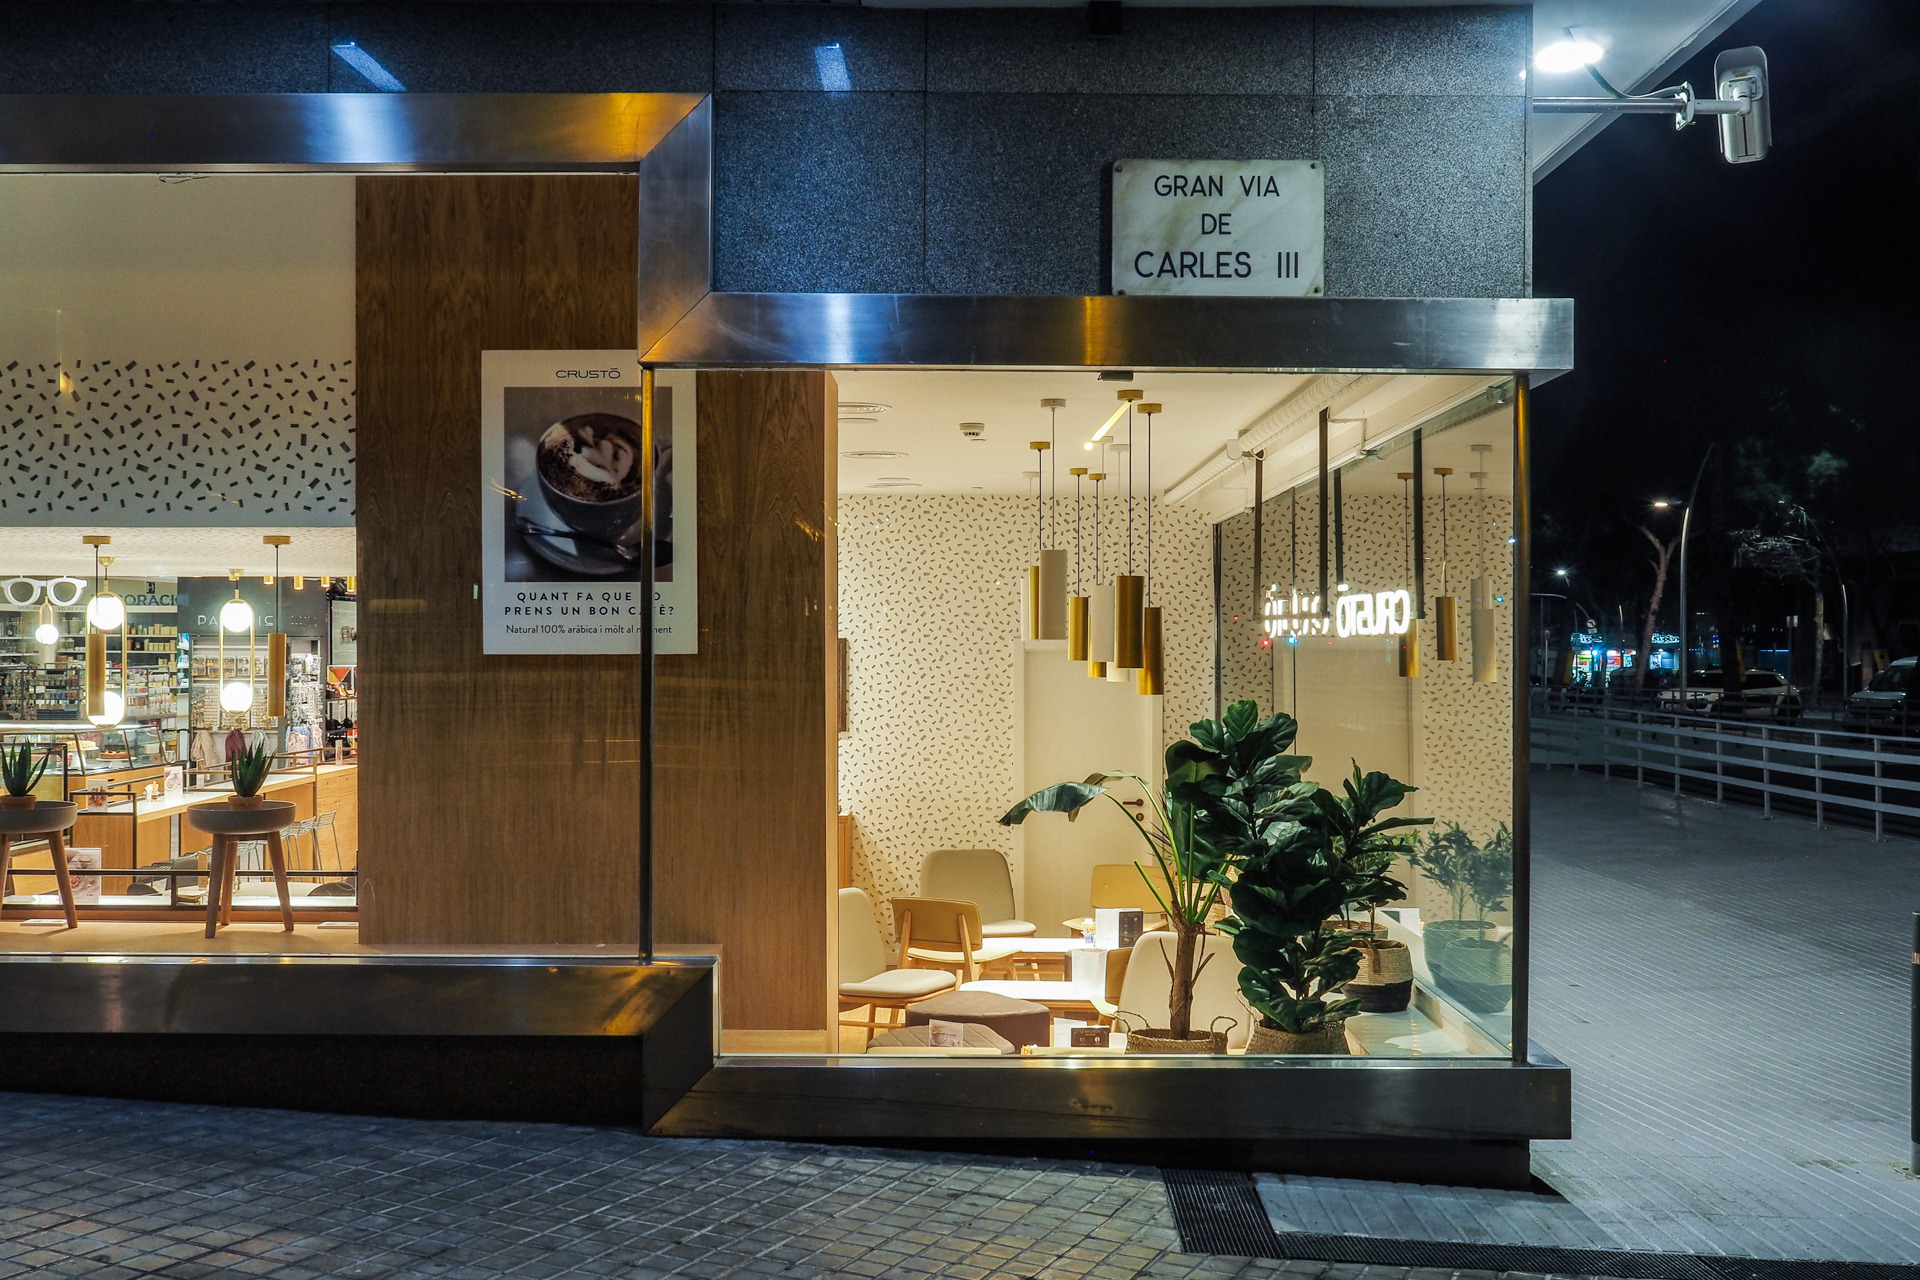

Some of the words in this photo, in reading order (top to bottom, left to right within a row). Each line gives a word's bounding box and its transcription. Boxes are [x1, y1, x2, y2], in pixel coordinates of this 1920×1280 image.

[1154, 174, 1224, 197] GRAN
[1239, 175, 1280, 197] VIA
[1201, 213, 1232, 235] DE
[1134, 250, 1252, 279] CARLES
[1277, 251, 1299, 279] III
[517, 592, 569, 603] QUANT
[577, 592, 594, 601] FA
[601, 592, 632, 603] QUE
[504, 606, 553, 615] PRENS
[561, 606, 581, 615] UN
[589, 606, 620, 615] BON
[628, 604, 674, 615] CÈ?
[197, 615, 274, 627] PAIS
[506, 624, 538, 634] Natural
[541, 624, 566, 634] 100%
[567, 624, 598, 634] aràbica
[600, 624, 603, 634] i
[605, 624, 624, 634] mòlt
[627, 624, 634, 634] al
